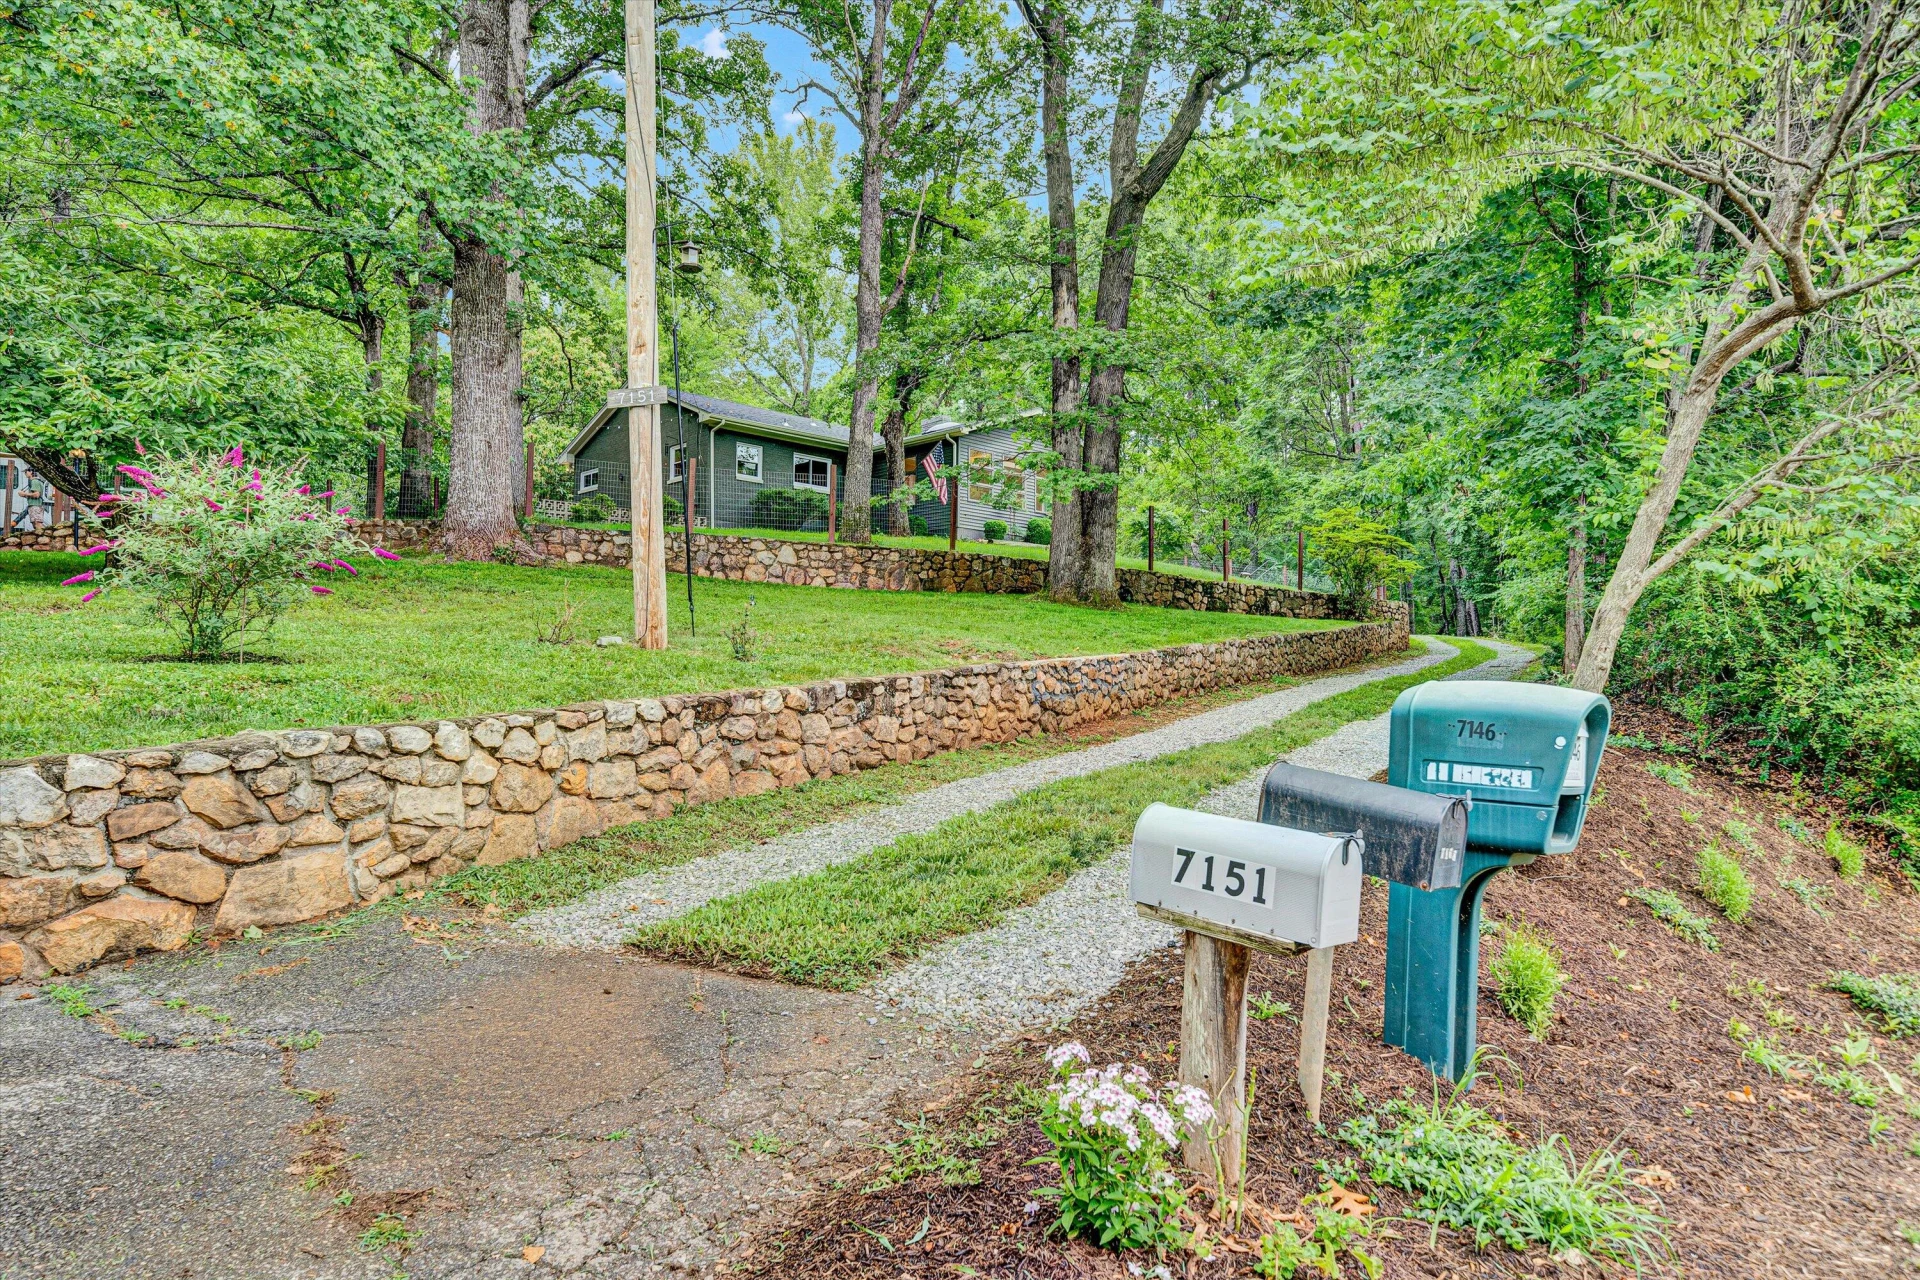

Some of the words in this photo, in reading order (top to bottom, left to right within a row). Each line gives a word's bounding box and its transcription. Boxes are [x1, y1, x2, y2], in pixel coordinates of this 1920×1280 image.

[617, 389, 655, 405] 7151
[1456, 719, 1496, 741] 7146
[1174, 848, 1266, 905] 7151
